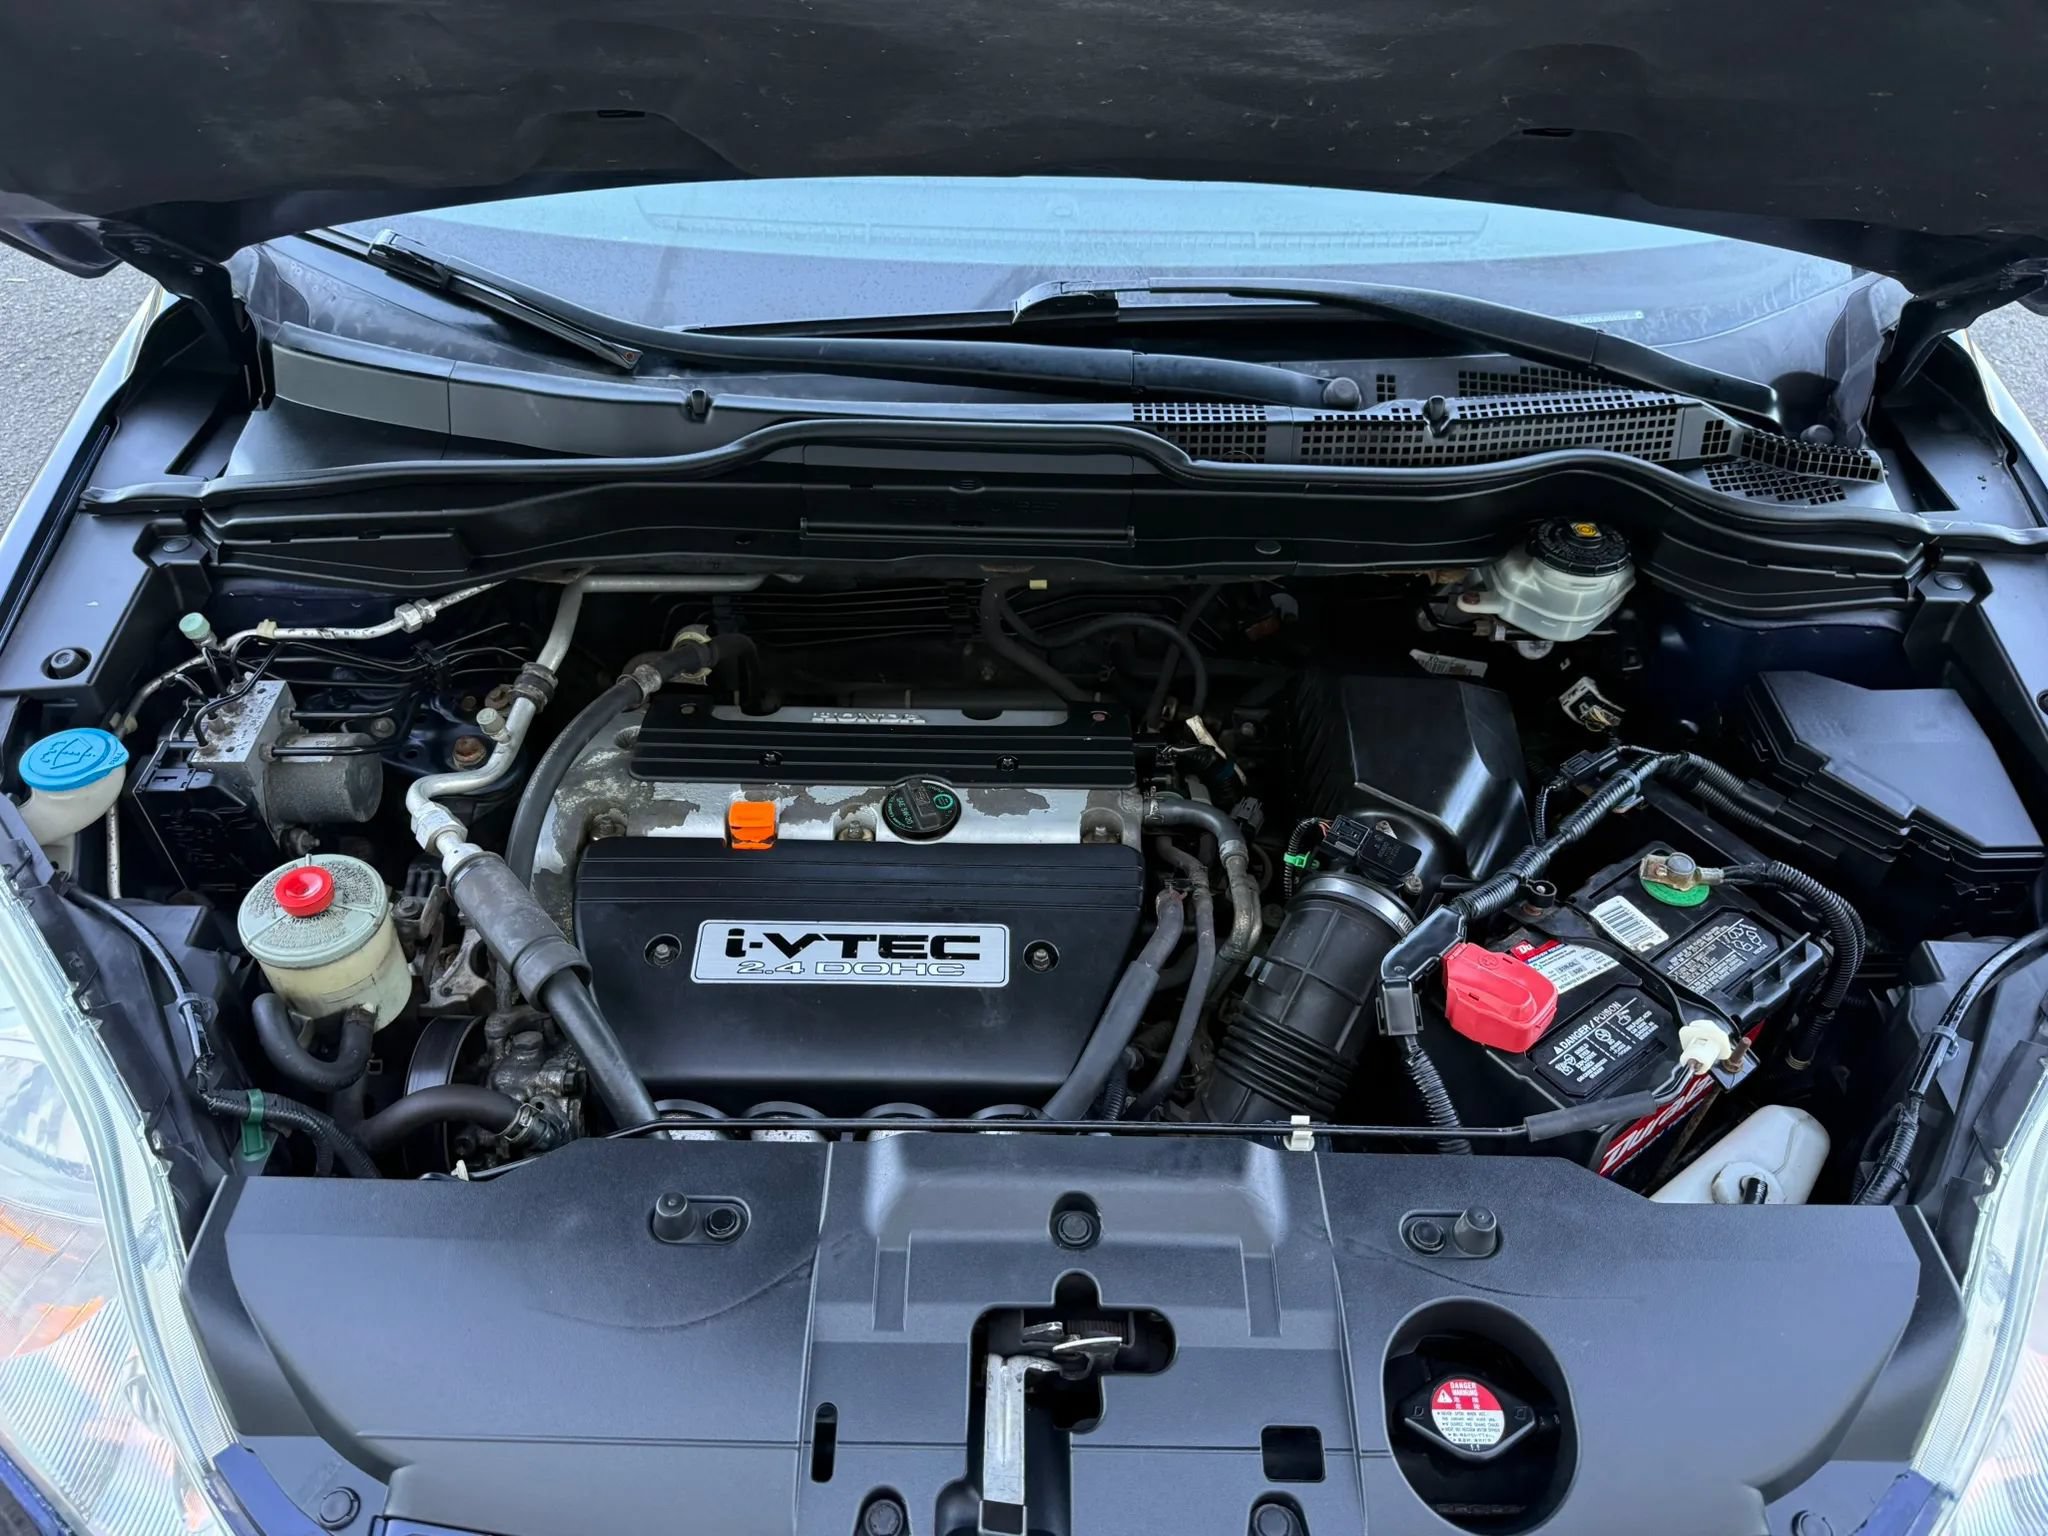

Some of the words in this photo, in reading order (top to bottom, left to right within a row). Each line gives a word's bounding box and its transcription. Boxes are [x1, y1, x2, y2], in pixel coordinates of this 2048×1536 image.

[896, 796, 905, 807] SAE
[900, 806, 913, 825] 5W-20
[725, 928, 981, 960] i-VTEC
[737, 961, 805, 975] 2.4
[815, 962, 965, 976] DOHC
[1559, 1024, 1590, 1050] DANGER
